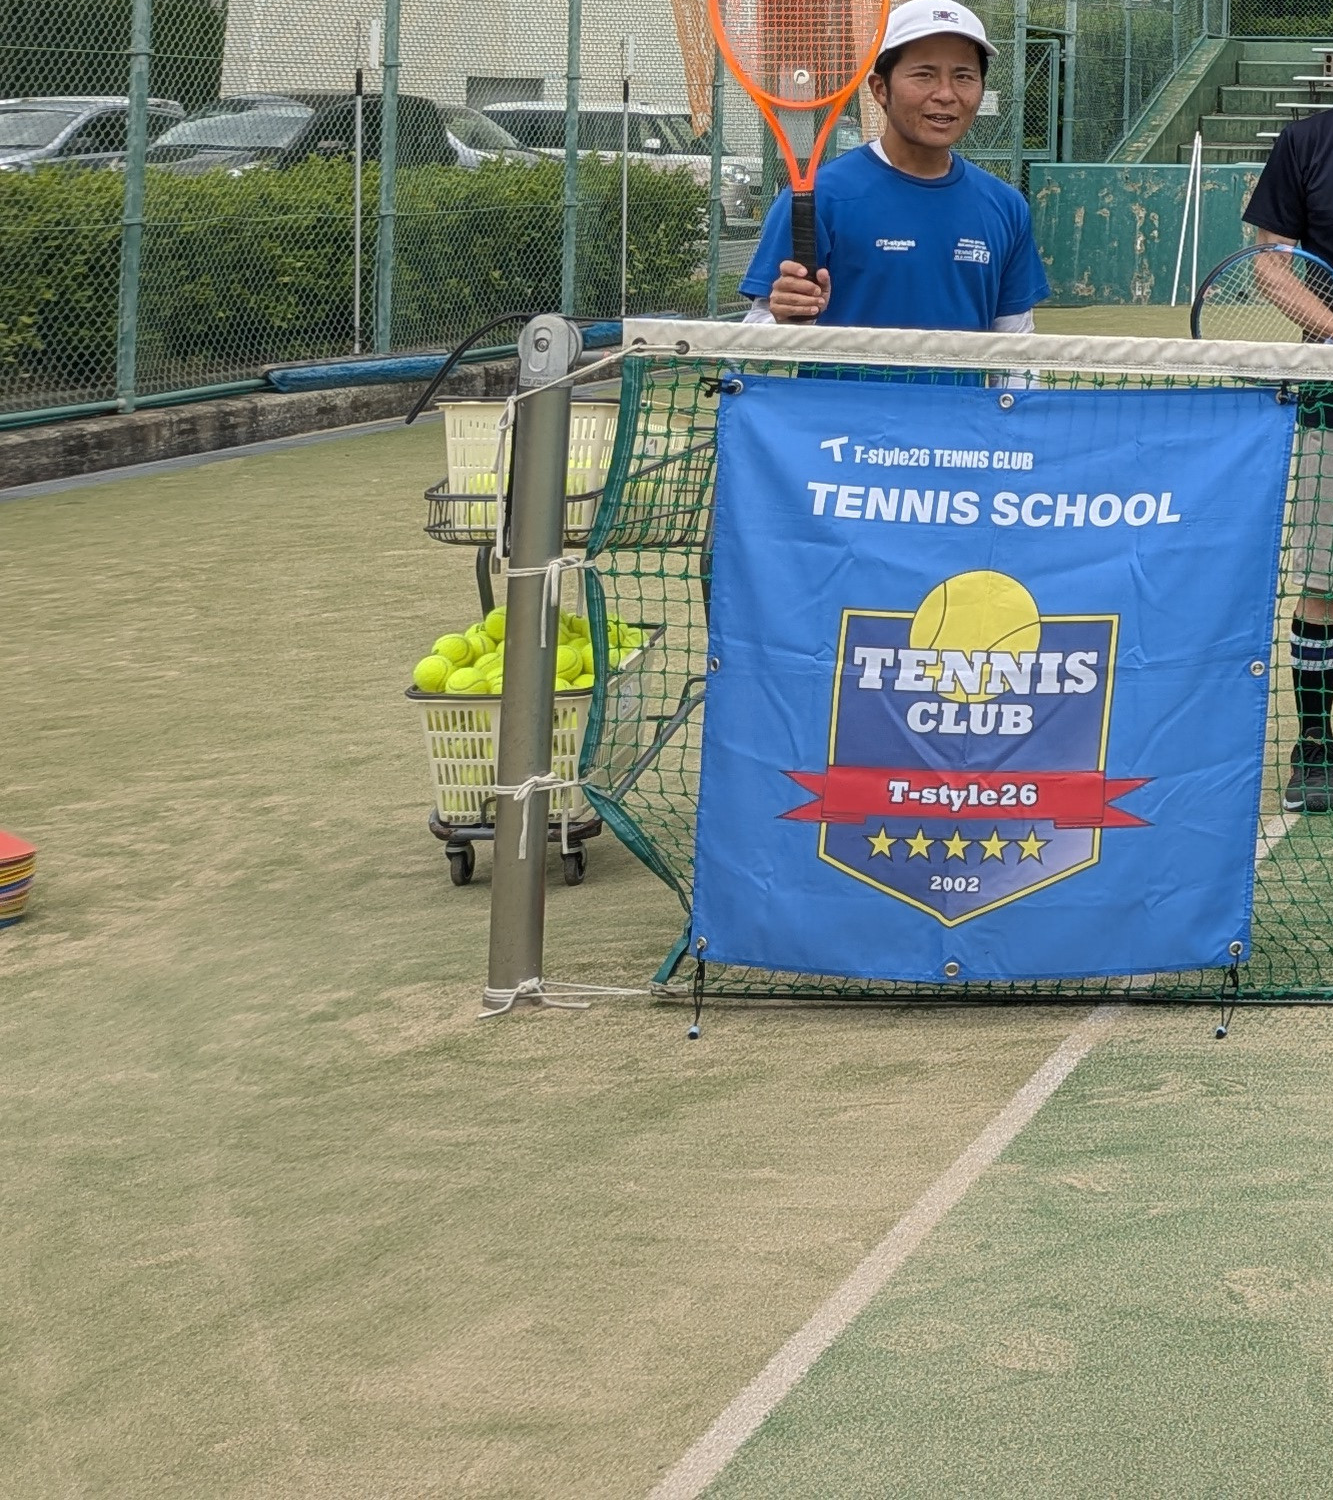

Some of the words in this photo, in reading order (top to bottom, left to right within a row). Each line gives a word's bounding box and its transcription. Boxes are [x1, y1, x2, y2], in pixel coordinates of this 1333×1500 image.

[854, 445, 930, 467] T-style26
[934, 449, 989, 469] TENNIS
[992, 450, 1034, 471] CLUB
[807, 481, 980, 525] TENNIS
[990, 491, 1182, 528] SCHOOL
[853, 647, 1098, 695] TENNIS
[906, 701, 1034, 735] CLUB
[888, 781, 1038, 812] T-style26
[930, 875, 980, 893] 2002
